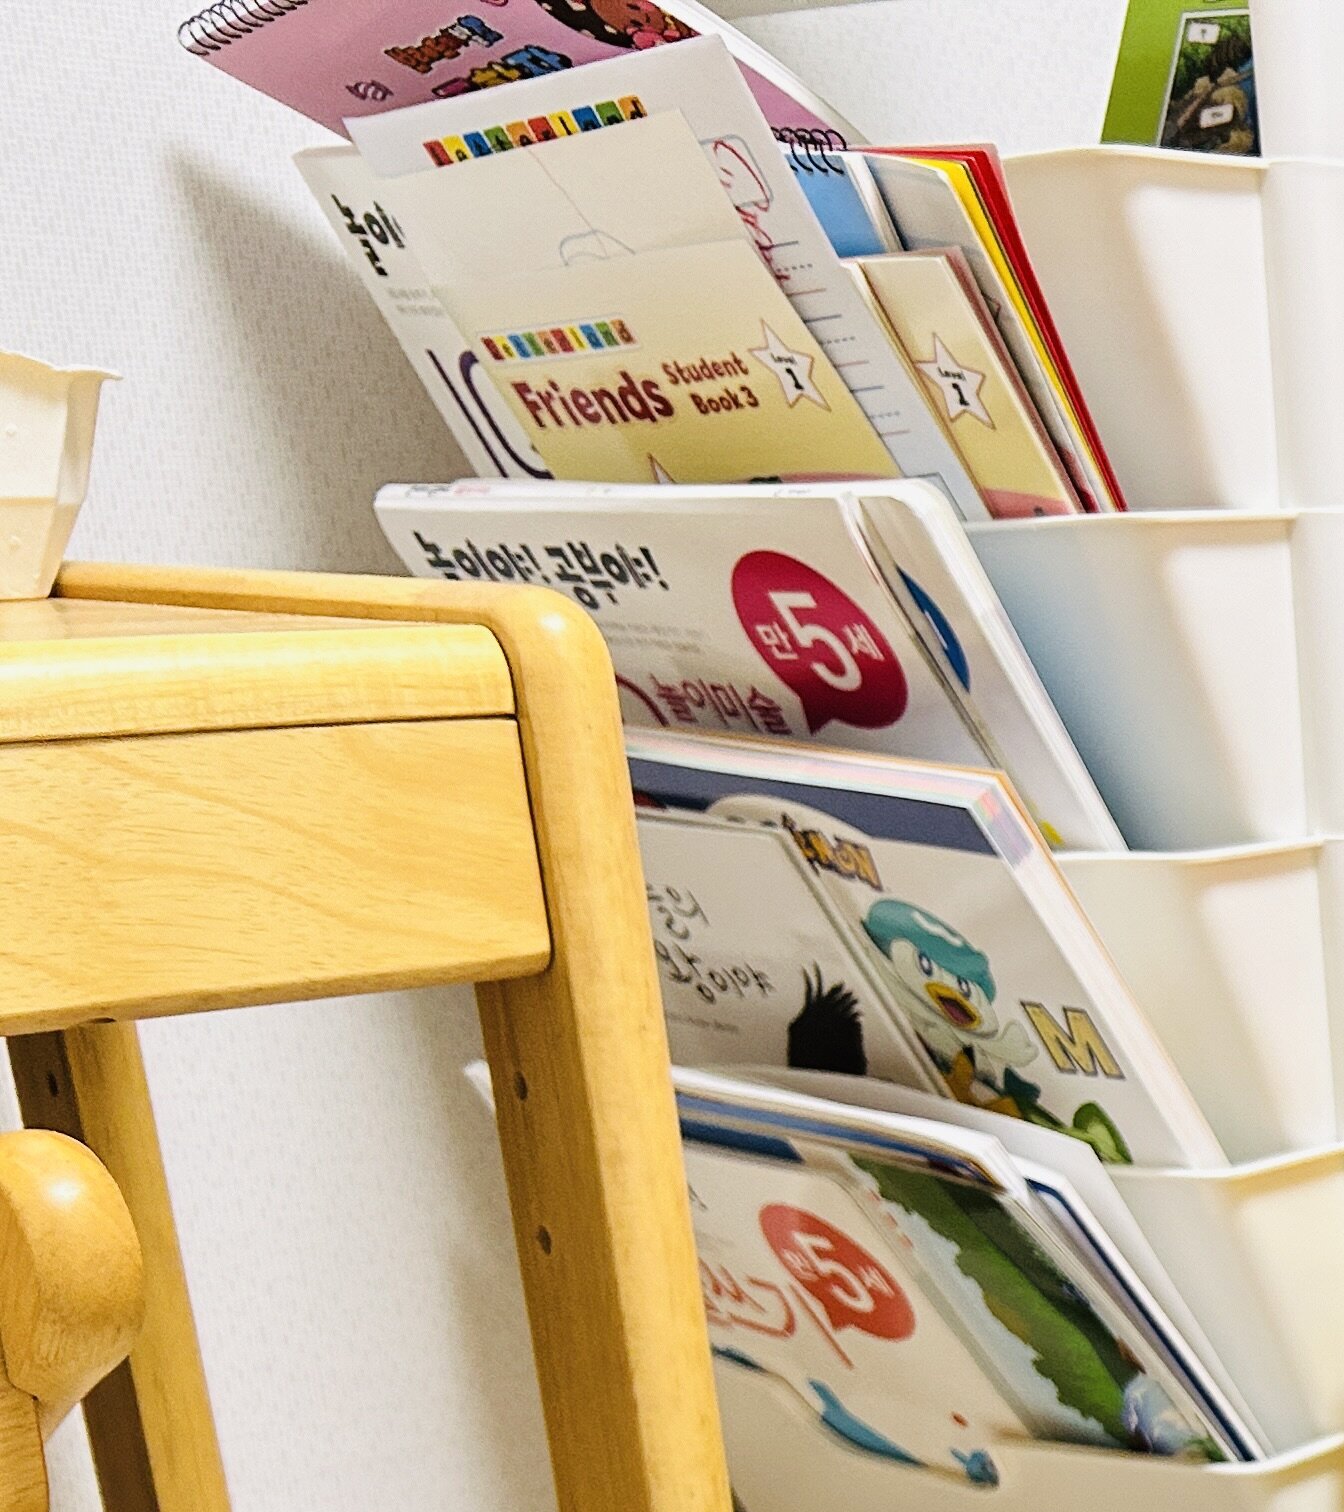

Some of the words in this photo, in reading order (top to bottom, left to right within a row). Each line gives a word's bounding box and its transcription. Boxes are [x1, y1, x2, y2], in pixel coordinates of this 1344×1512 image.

[661, 352, 749, 386] Student
[786, 368, 804, 391] 1
[511, 370, 676, 428] Friends
[692, 390, 742, 416] Book
[740, 386, 761, 409] 3
[545, 540, 670, 610] 공부야!
